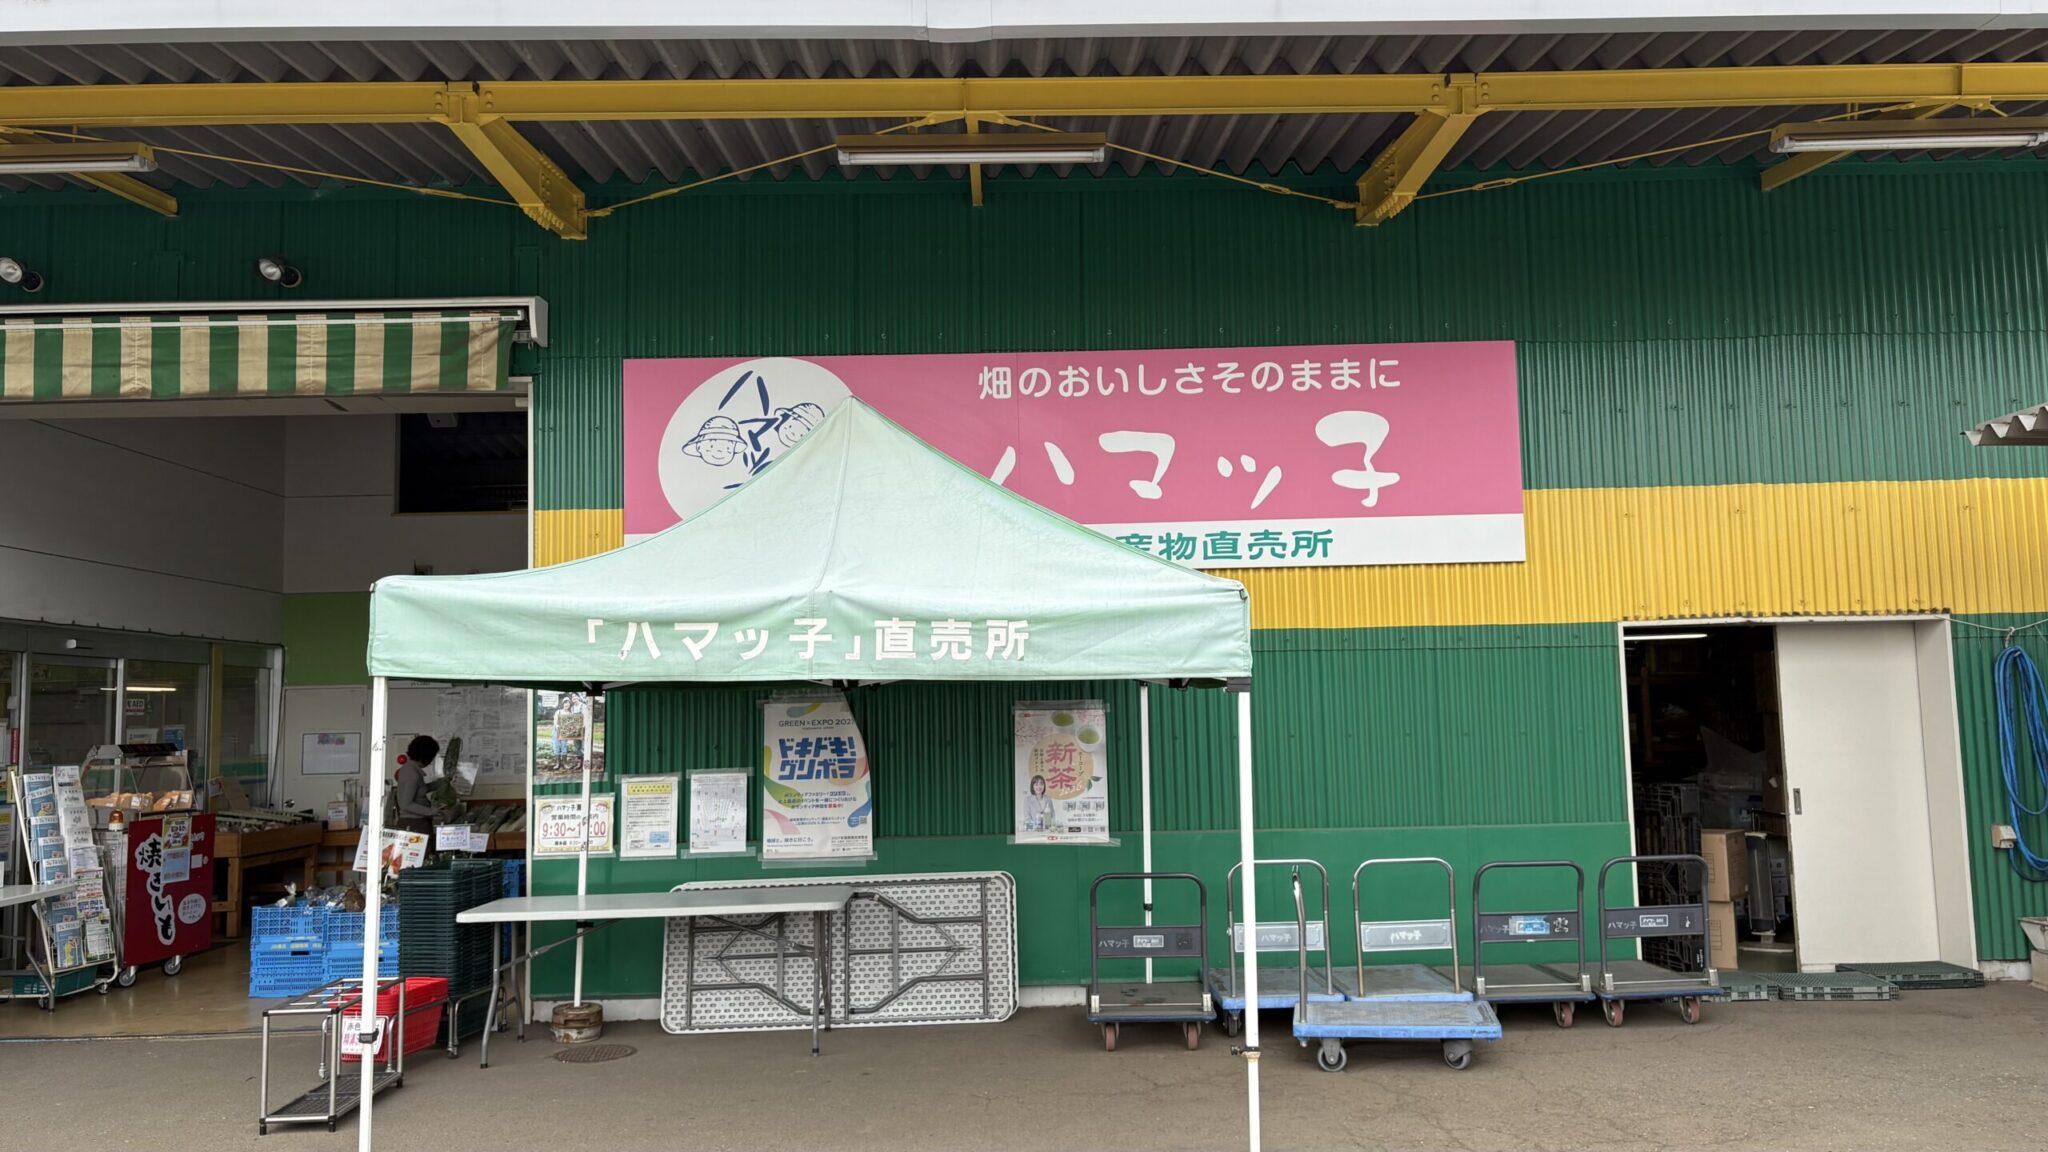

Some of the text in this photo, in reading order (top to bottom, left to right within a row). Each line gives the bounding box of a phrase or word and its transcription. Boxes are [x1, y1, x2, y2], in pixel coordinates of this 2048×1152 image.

[978, 358, 1401, 400] 畑のおいしさそのままに
[990, 410, 1400, 509] ハマッ子
[587, 616, 1030, 661] 「ハマッ子」直売所
[1045, 741, 1078, 790] 新茶
